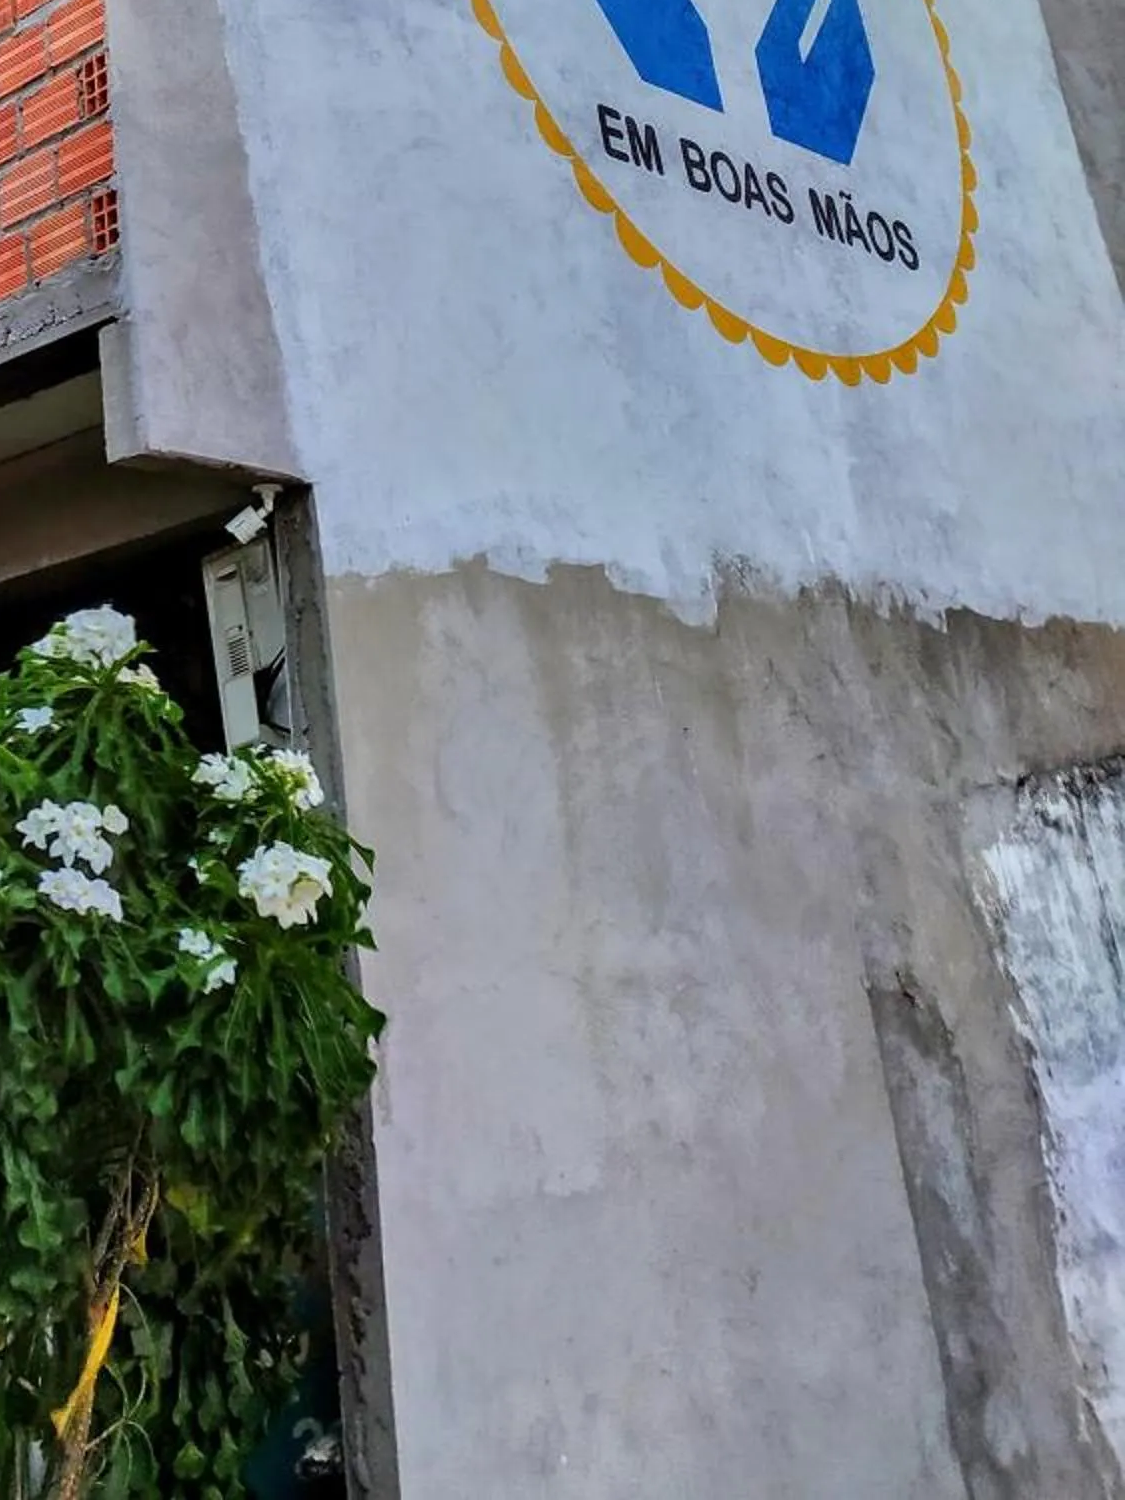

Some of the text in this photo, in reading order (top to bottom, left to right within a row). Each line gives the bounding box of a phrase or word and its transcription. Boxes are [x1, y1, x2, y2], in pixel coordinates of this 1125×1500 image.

[597, 104, 919, 271] EM BOAS MÃOS
